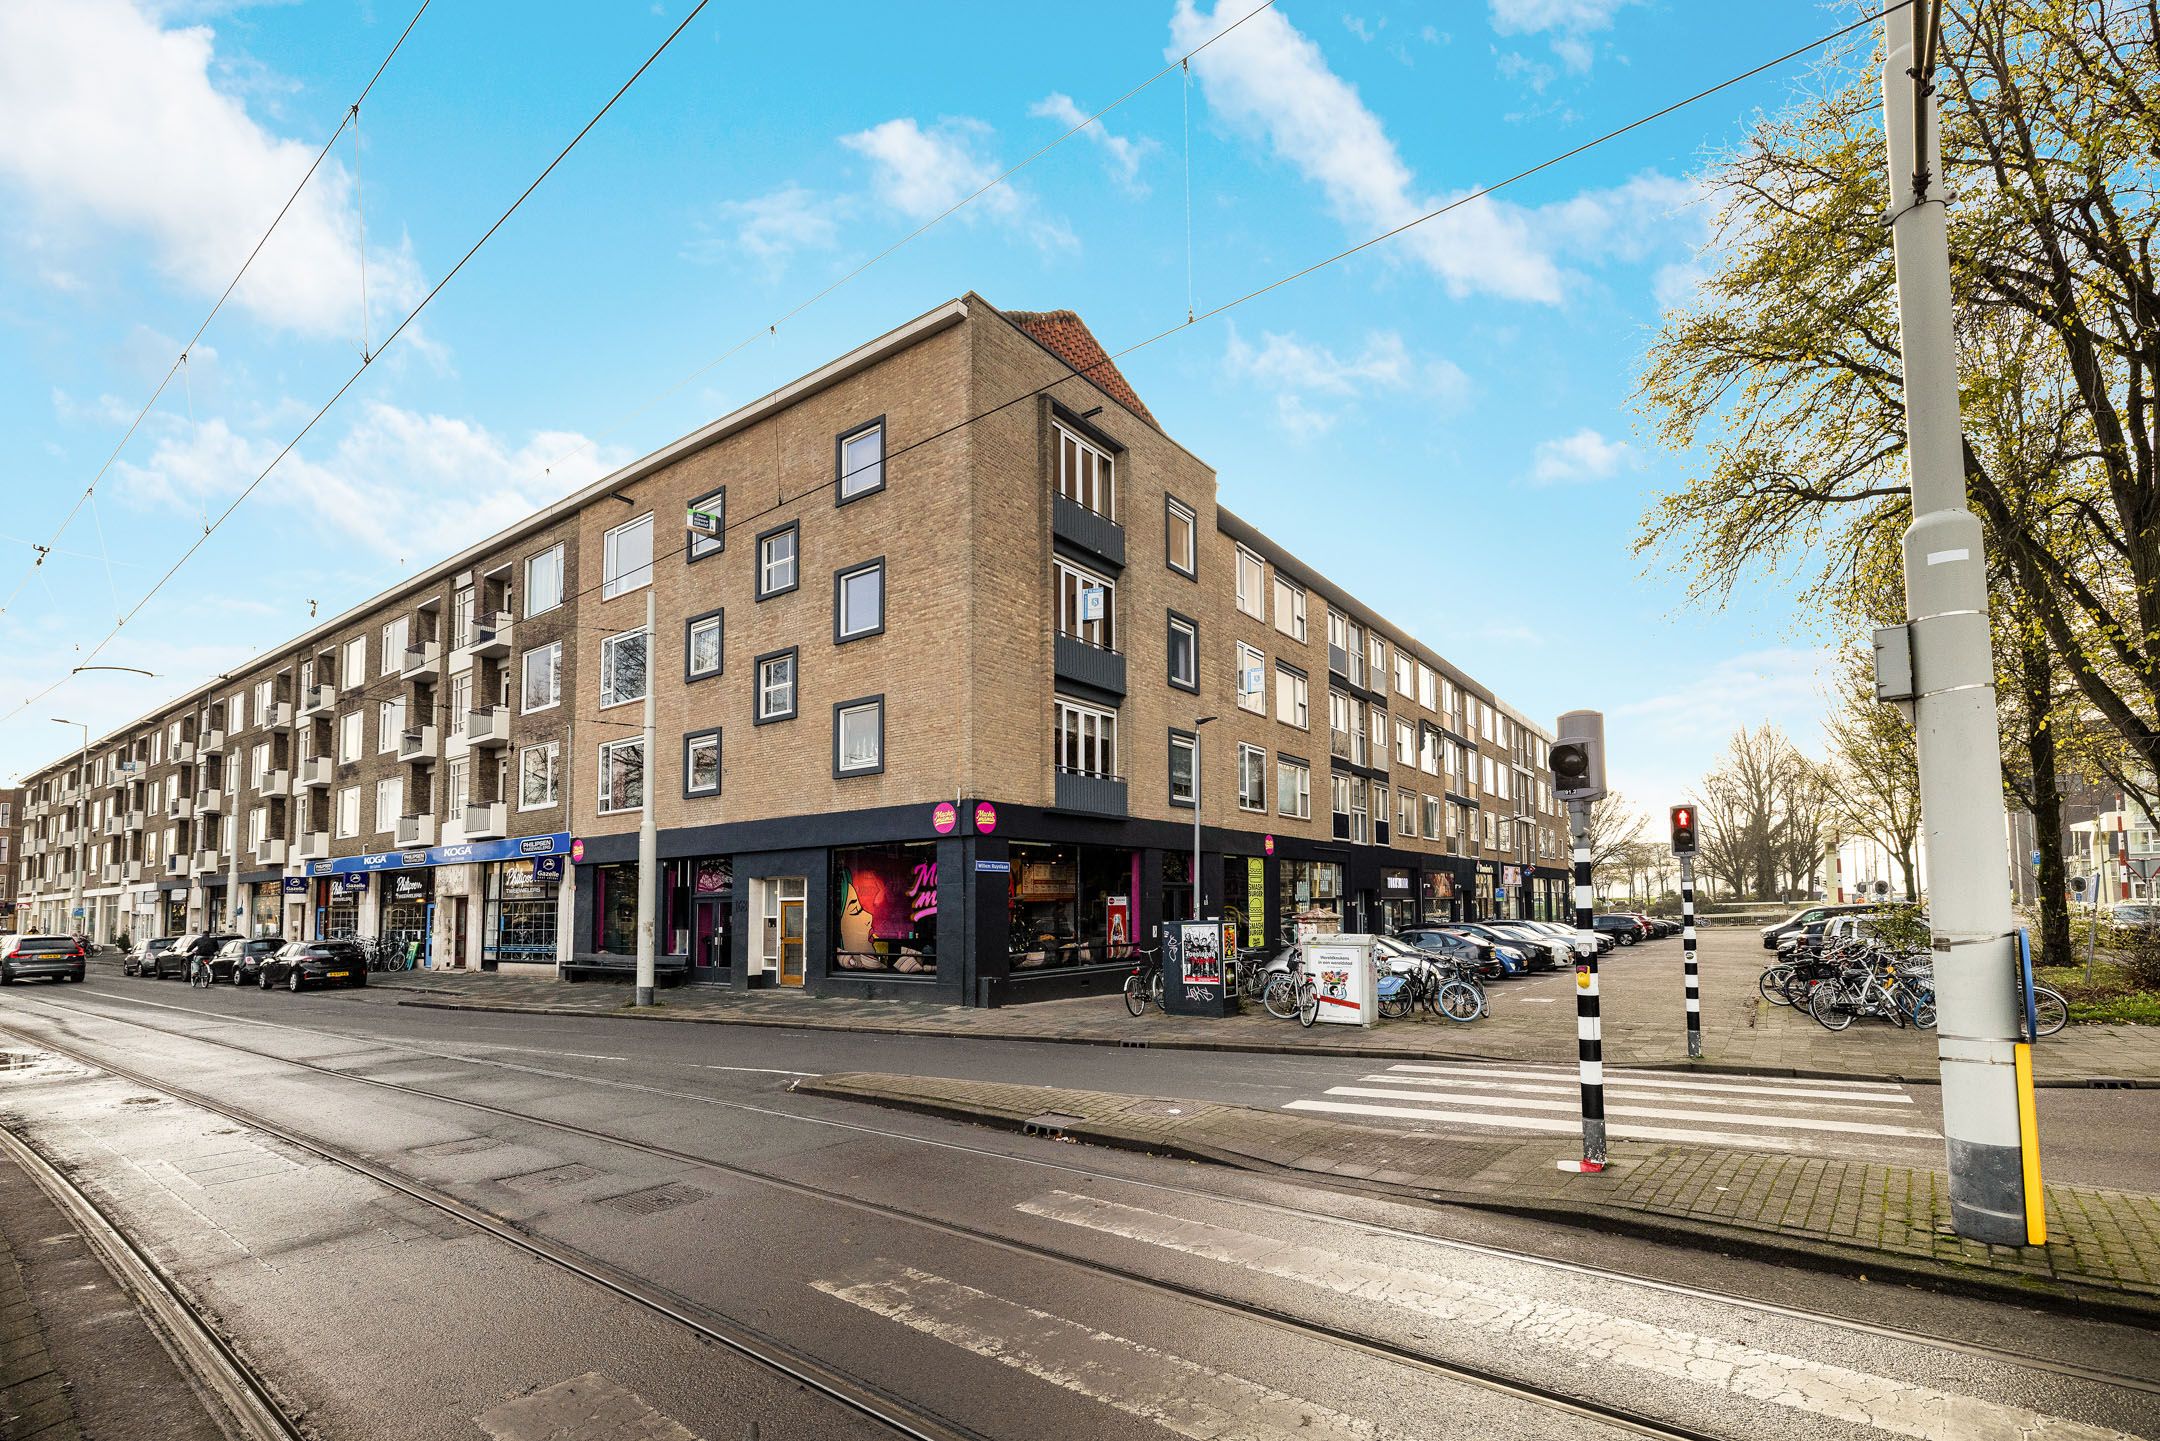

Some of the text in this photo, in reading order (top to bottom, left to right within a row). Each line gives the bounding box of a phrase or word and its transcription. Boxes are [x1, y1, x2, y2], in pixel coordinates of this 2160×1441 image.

[443, 846, 470, 857] KOGA
[363, 855, 387, 865] KOGA
[536, 869, 560, 878] Gazelle
